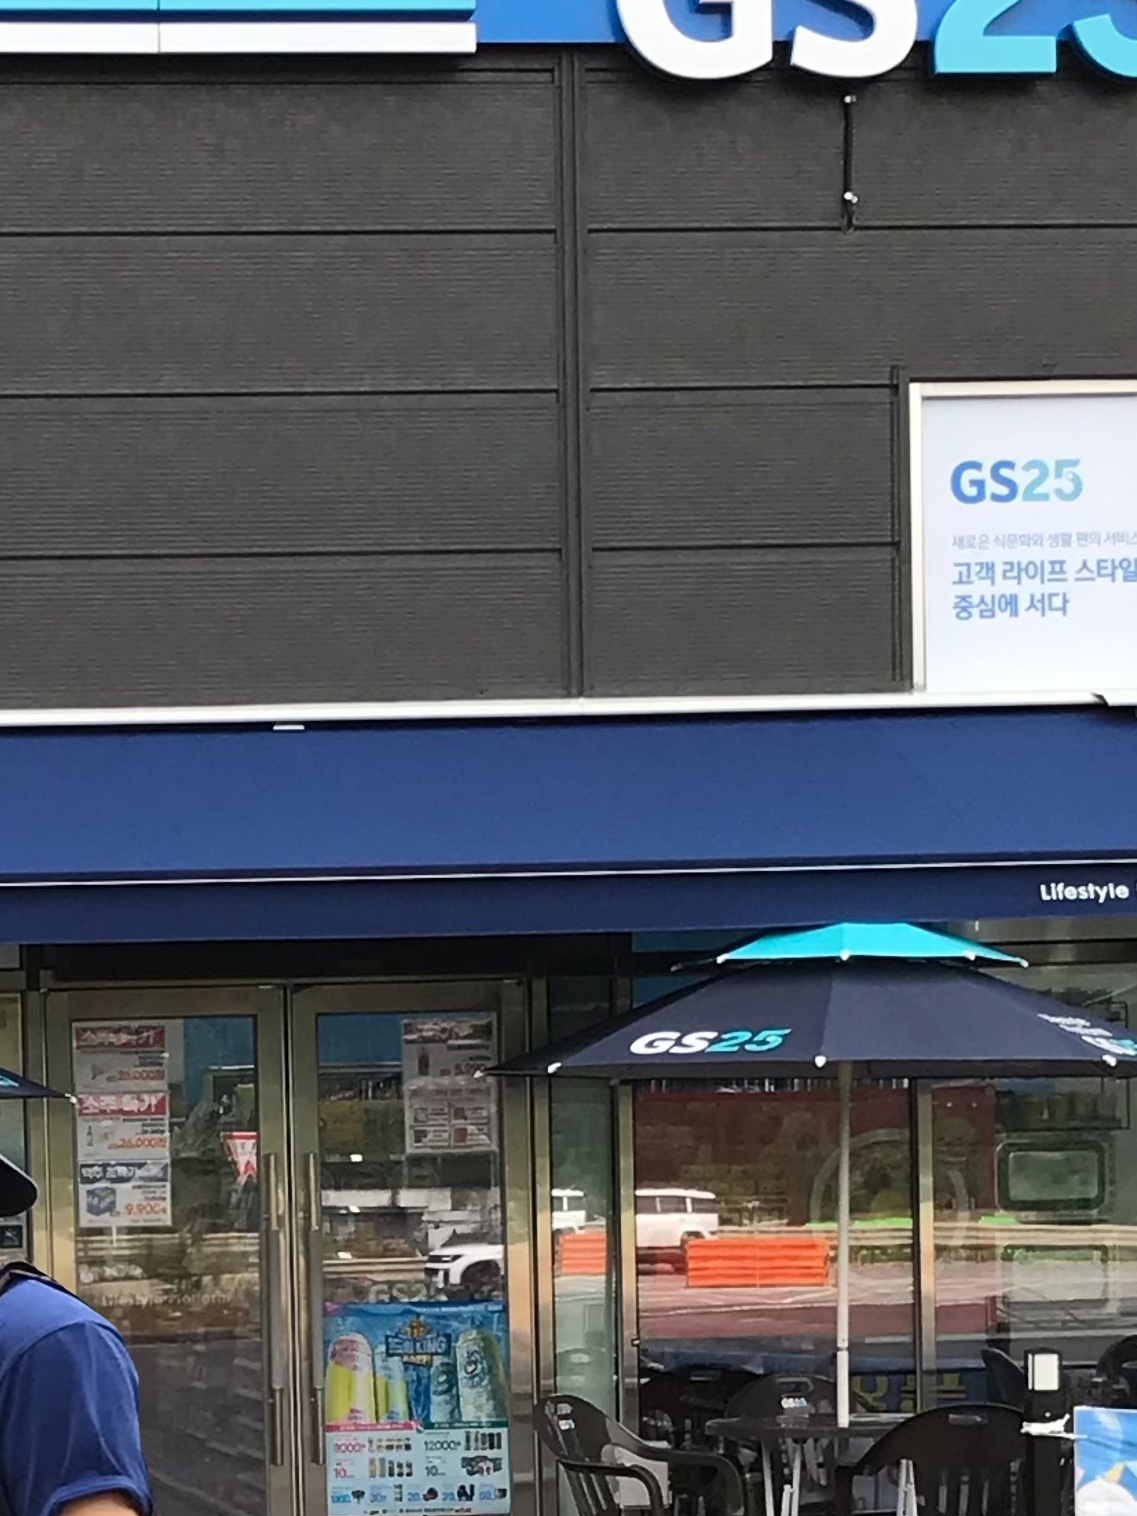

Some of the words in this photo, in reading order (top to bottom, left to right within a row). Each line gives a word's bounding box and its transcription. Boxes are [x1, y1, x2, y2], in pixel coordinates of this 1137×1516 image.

[950, 458, 1084, 504] GS25
[951, 560, 996, 587] 고객
[1002, 559, 1068, 586] 라이프
[1074, 557, 1137, 583] 스타일
[952, 592, 1019, 621] 중심에
[1024, 591, 1070, 618] 서다
[1040, 882, 1129, 904] Lifestyle
[629, 1028, 792, 1055] GS25
